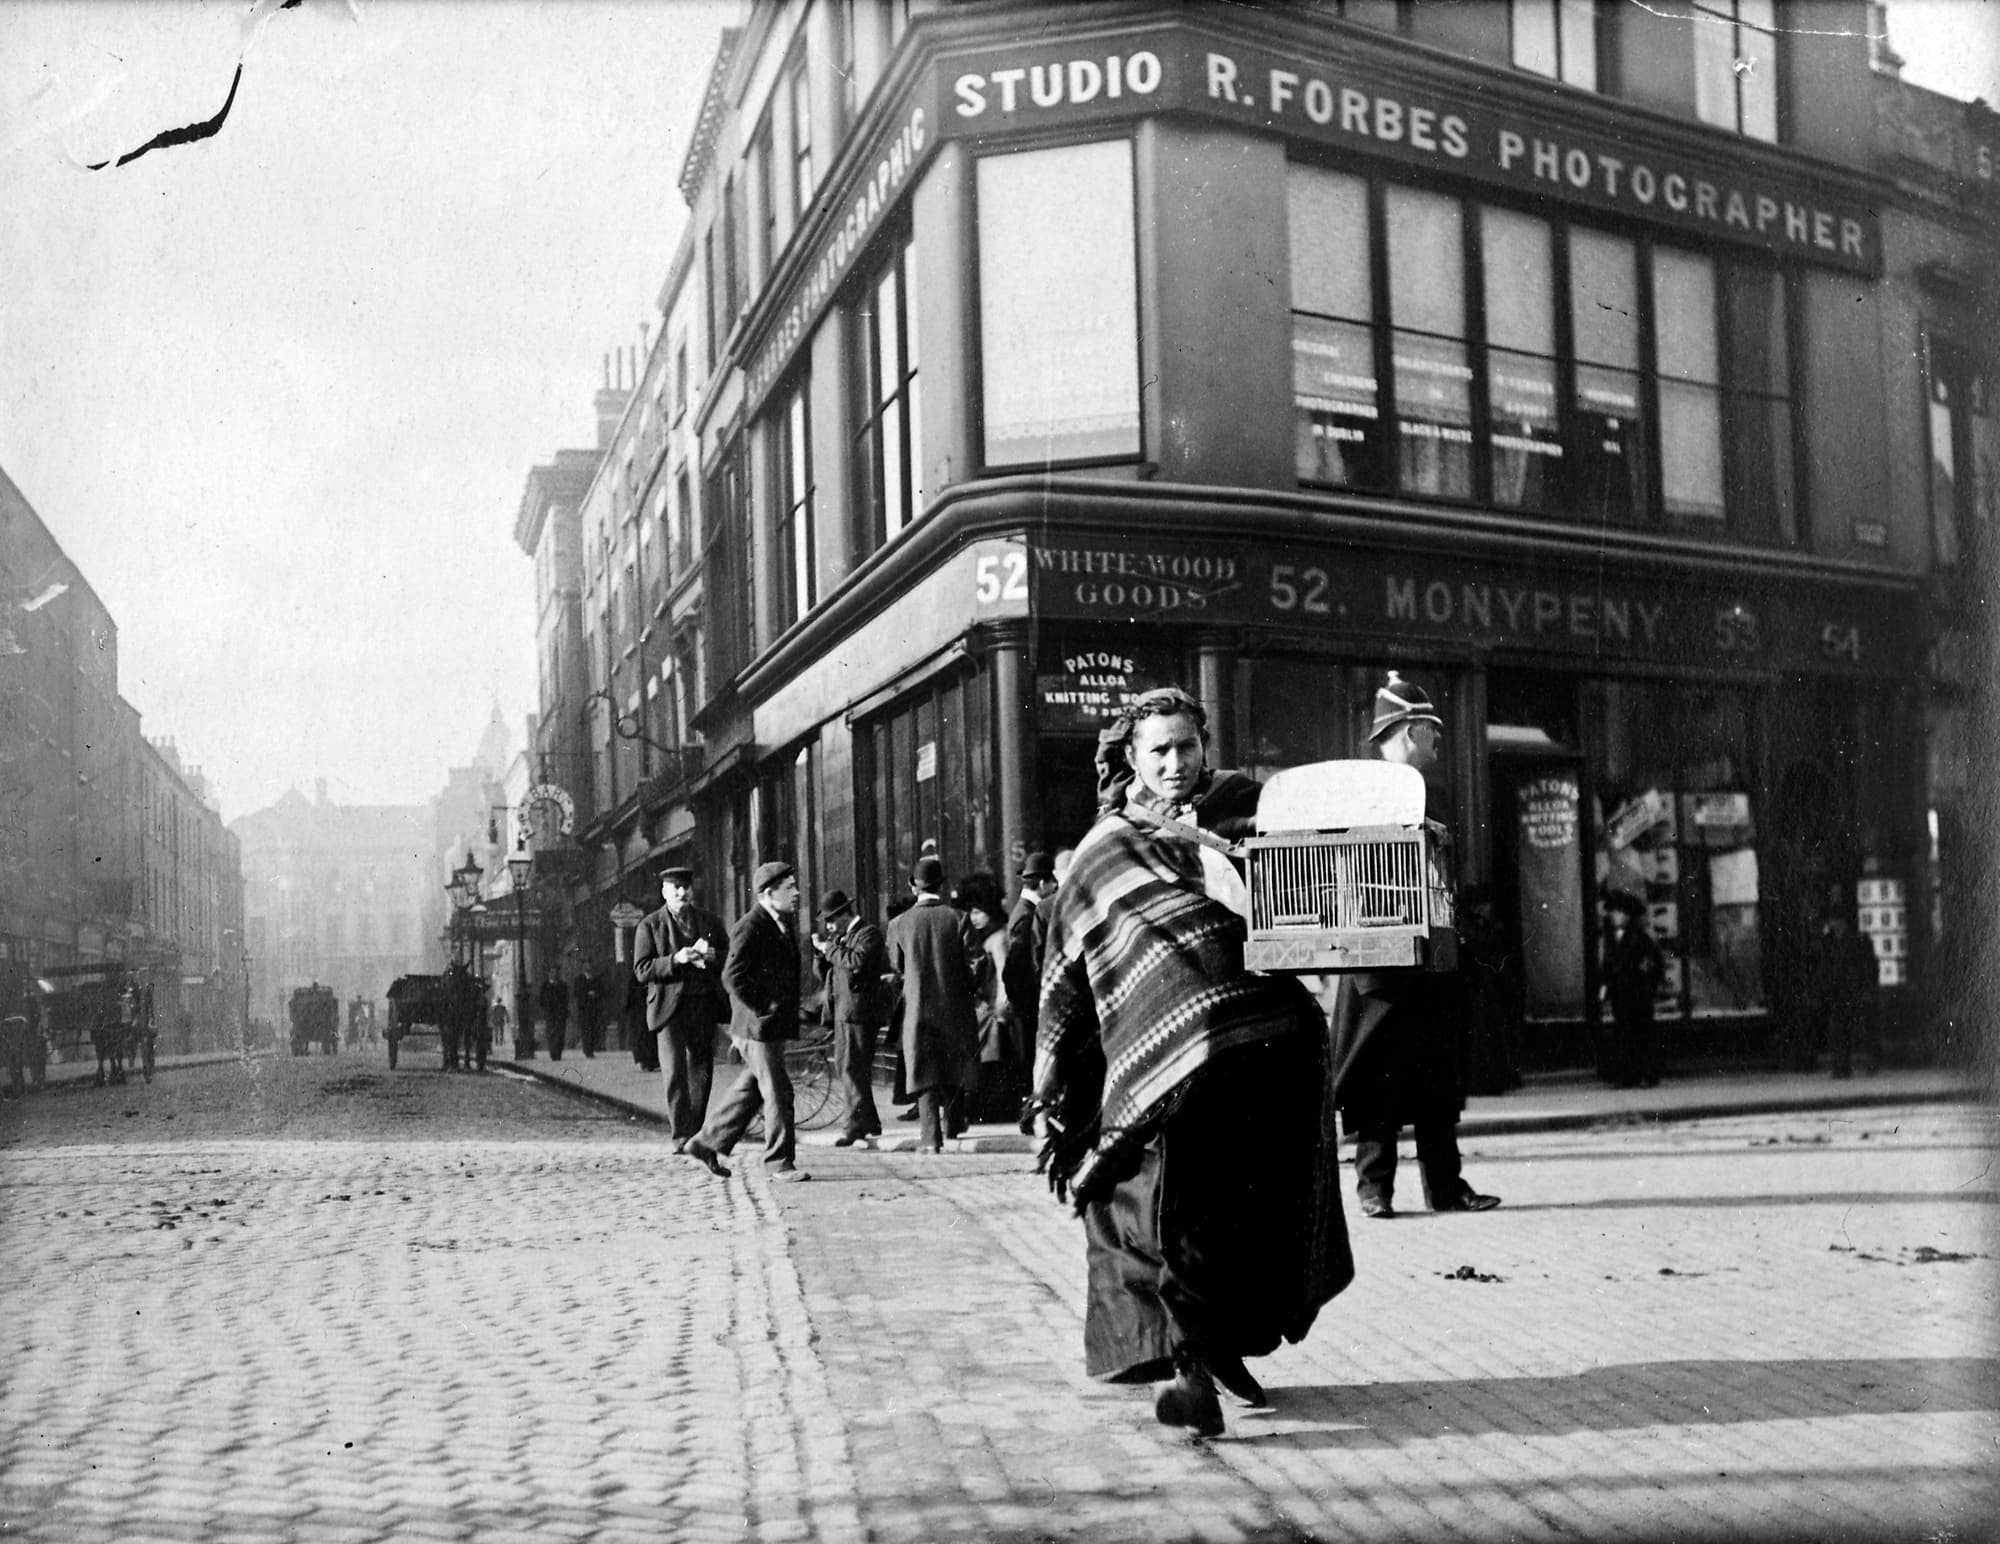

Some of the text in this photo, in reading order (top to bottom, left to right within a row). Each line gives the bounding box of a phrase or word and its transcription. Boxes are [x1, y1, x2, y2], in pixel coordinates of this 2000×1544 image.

[954, 51, 1162, 117] STUDIO
[1207, 52, 1865, 260] R. FORBES PHOTOGRAPHER
[802, 107, 926, 323] PHOTOGRAPHIC
[976, 551, 1029, 603] 52
[1075, 583, 1208, 610] GOODS
[1822, 622, 1860, 661] 54
[1064, 651, 1135, 674] PATONS
[1079, 674, 1127, 687] ALLOA
[1044, 691, 1111, 705] KNITTING
